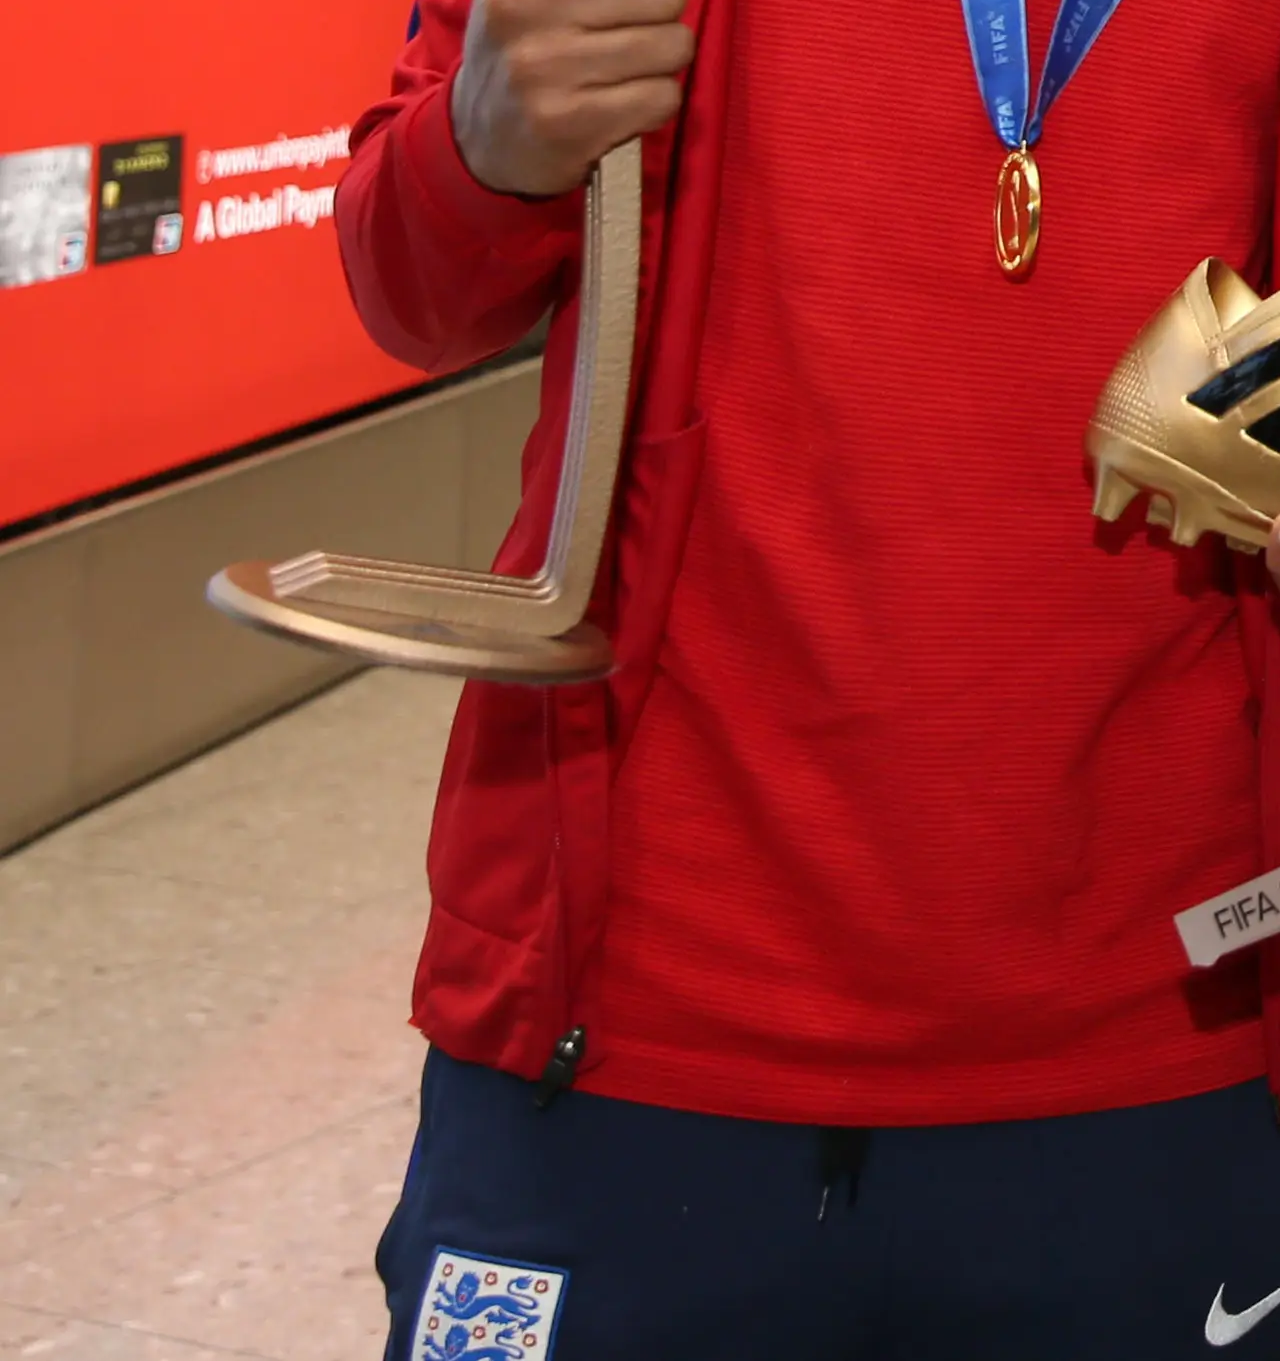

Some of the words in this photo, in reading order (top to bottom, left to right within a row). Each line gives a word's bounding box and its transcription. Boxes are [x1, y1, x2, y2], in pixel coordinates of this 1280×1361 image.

[194, 199, 216, 244] A
[216, 188, 282, 239] Global
[1213, 894, 1280, 939] FIFA
